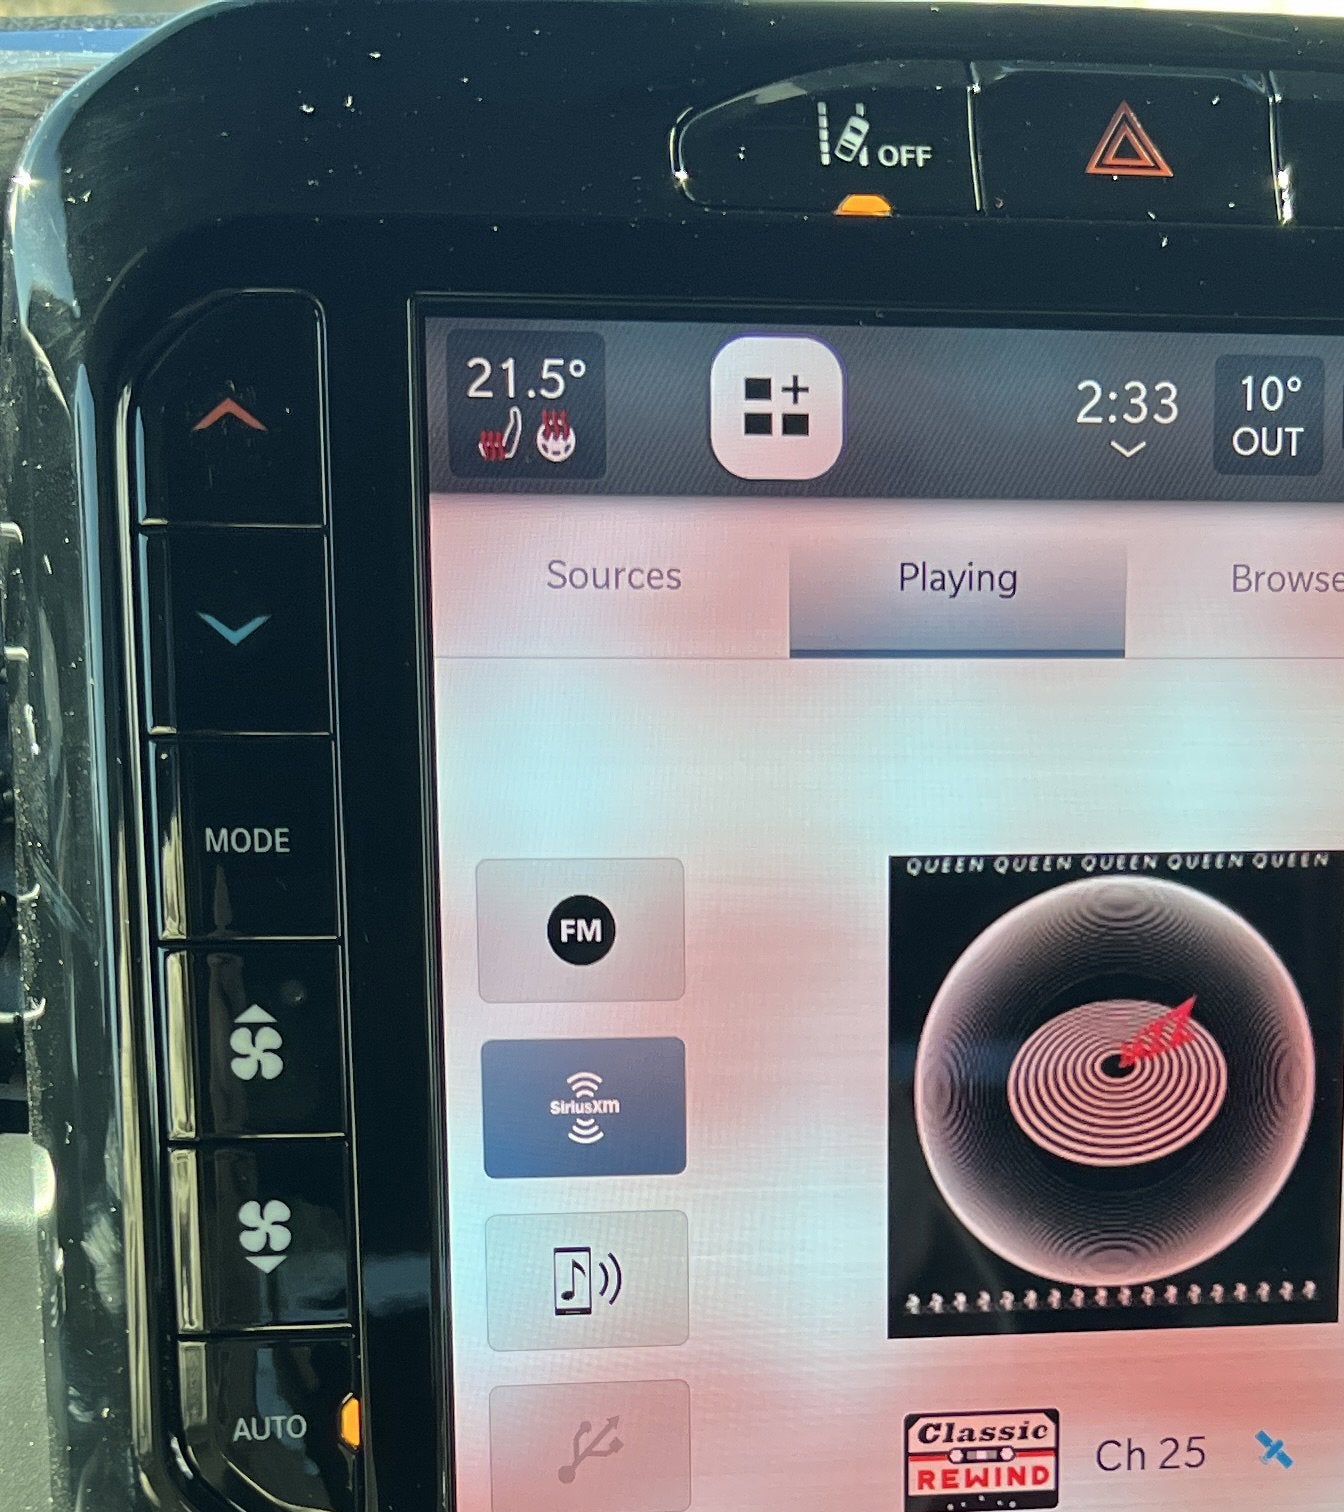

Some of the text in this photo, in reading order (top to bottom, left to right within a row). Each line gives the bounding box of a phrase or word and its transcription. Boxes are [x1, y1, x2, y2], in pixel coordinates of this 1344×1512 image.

[877, 144, 933, 169] OFF
[466, 357, 586, 400] 21.5°
[1075, 380, 1179, 425] 2:33
[1241, 375, 1302, 412] 10°
[1232, 427, 1304, 457] OUT
[547, 560, 682, 591] Sources
[899, 561, 1017, 599] Playing
[205, 828, 291, 853] MODE
[906, 852, 1330, 876] QUEEN QUEEN QUEEN QUEEN QUEEN
[560, 920, 602, 943] FM
[233, 1416, 307, 1441] AUTO
[916, 1419, 1049, 1445] Classic
[1096, 1436, 1207, 1472] Ch 25
[916, 1465, 1050, 1491] REWIND
